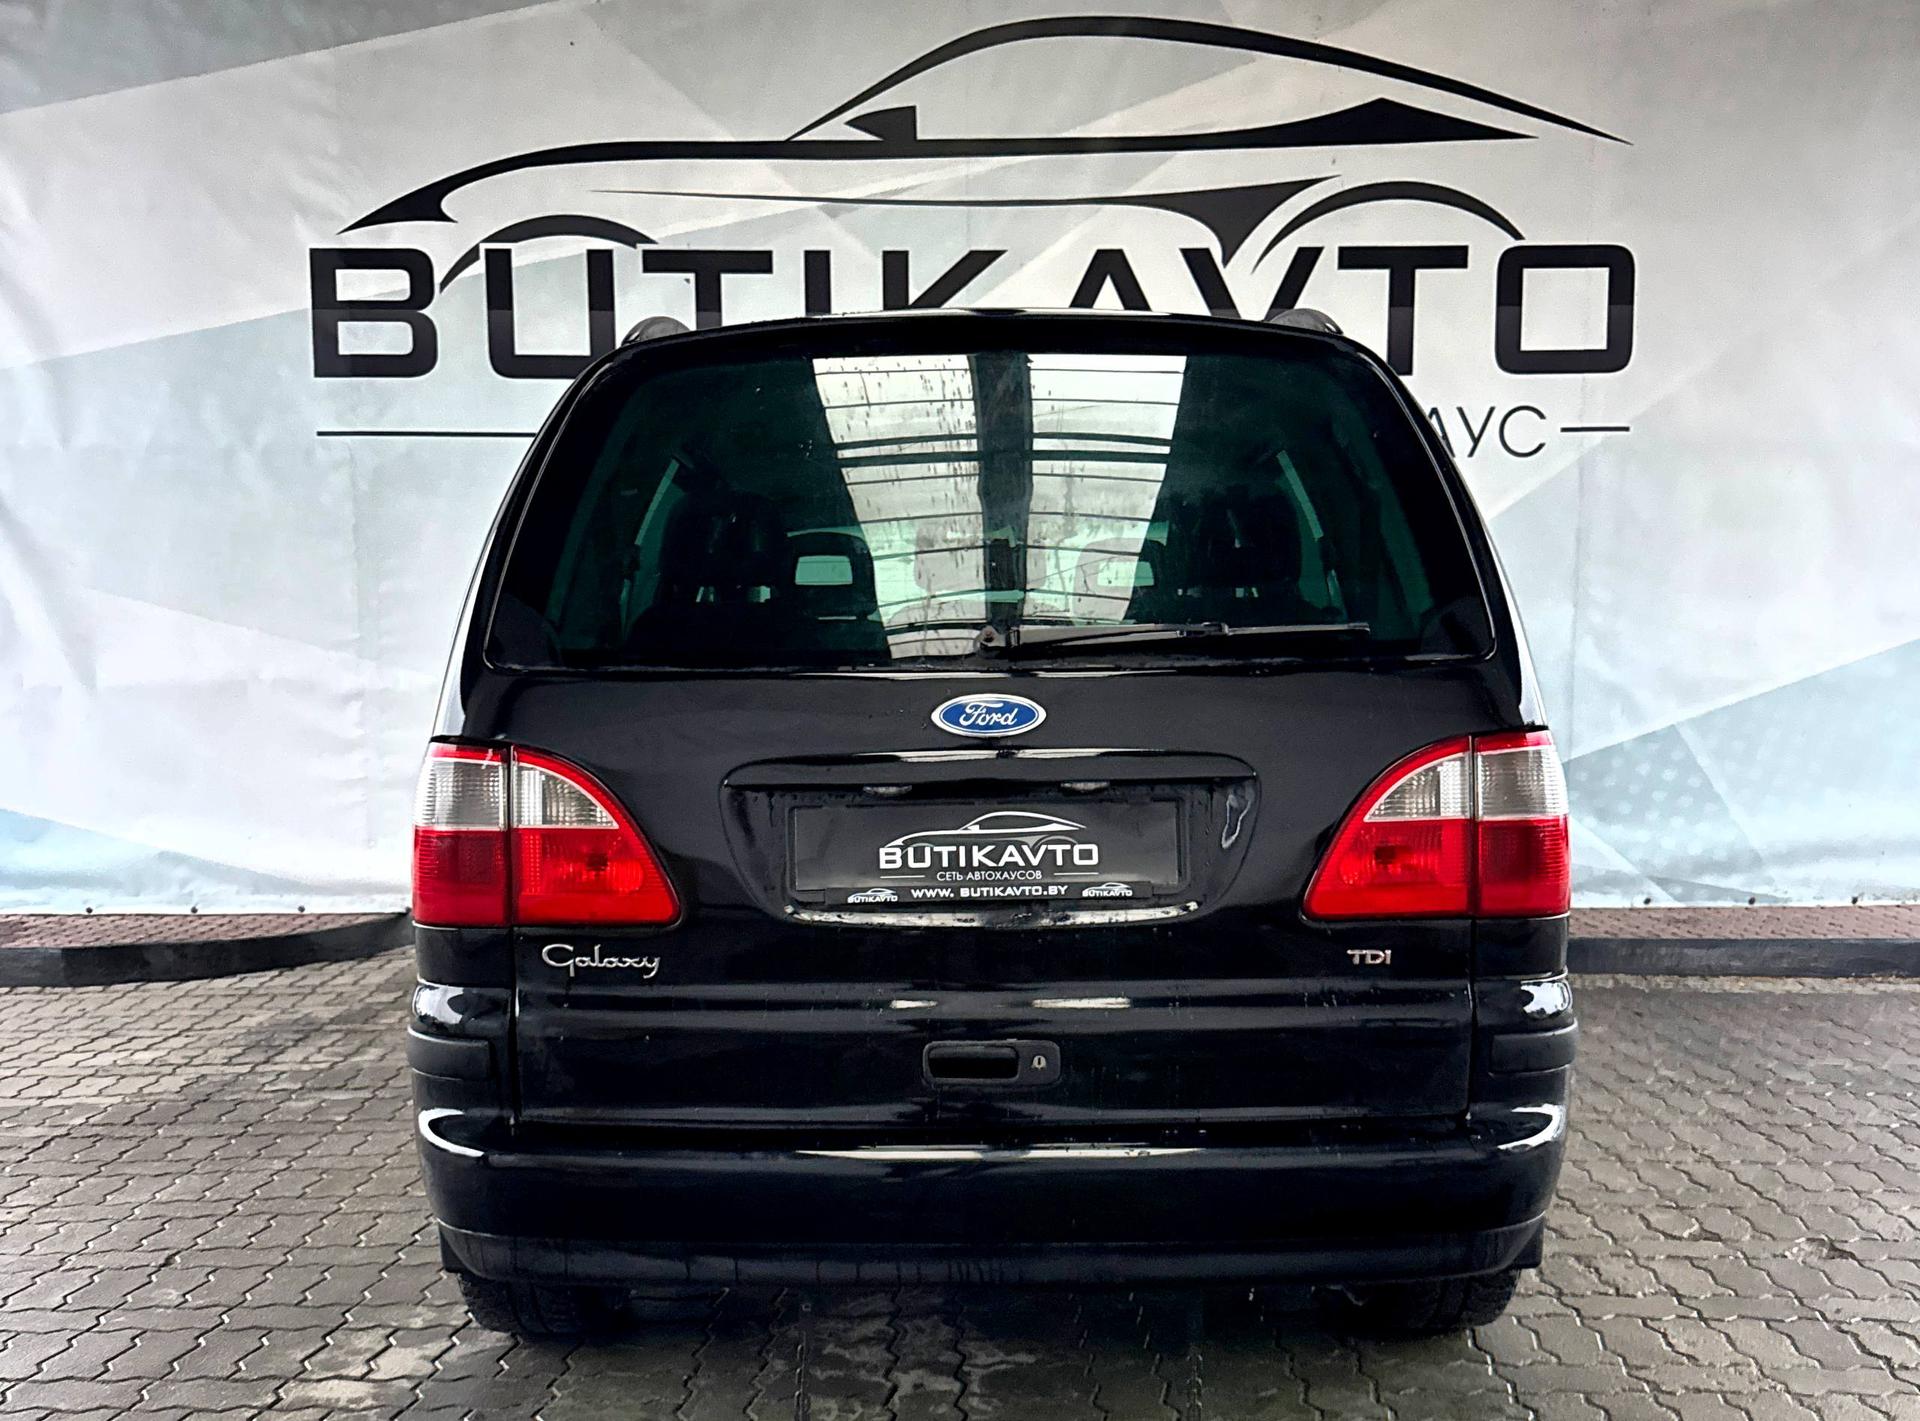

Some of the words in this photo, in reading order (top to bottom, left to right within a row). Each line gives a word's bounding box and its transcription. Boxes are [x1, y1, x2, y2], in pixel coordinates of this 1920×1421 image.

[959, 702, 1018, 726] Ford
[879, 843, 1099, 869] BUTIKAVTO
[936, 871, 963, 881] СЕТЬ
[966, 870, 1042, 880] АВТОХАУСОВ
[911, 887, 955, 898] WWW.
[960, 885, 1068, 897] BUTIKAVTO.BY
[1082, 889, 1133, 897] BUTIKAVTO
[847, 895, 898, 903] BUTIKAVTO
[542, 943, 660, 979] Galaxy
[1346, 949, 1392, 965] TDI
